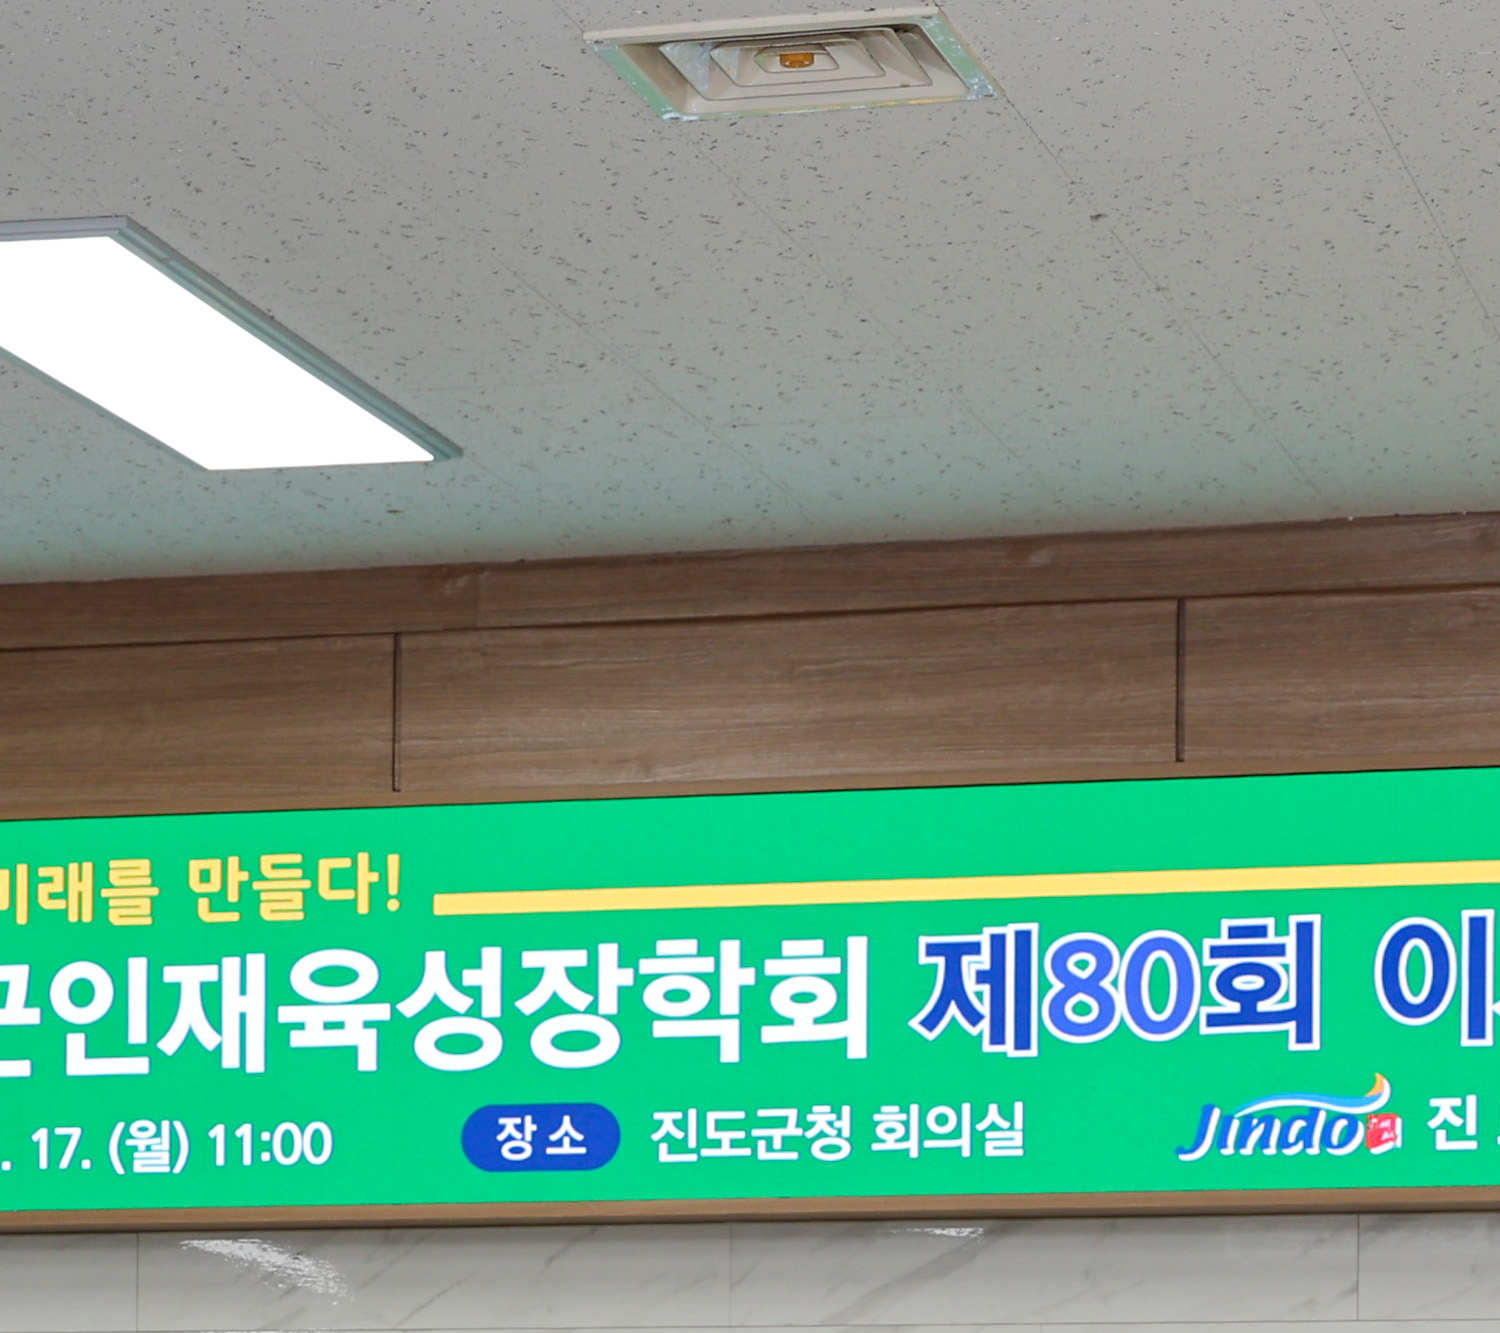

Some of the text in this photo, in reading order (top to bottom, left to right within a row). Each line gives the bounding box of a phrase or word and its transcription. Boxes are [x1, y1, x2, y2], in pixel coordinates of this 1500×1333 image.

[188, 850, 402, 923] 만들다!
[909, 912, 1323, 1059] 제80회
[31, 1125, 91, 1171] 17.
[108, 1118, 190, 1176] (월)
[208, 1121, 333, 1168] 11:00
[495, 1101, 1026, 1163] 장소 진도군청 회의실
[1175, 1103, 1366, 1162] Jindo
